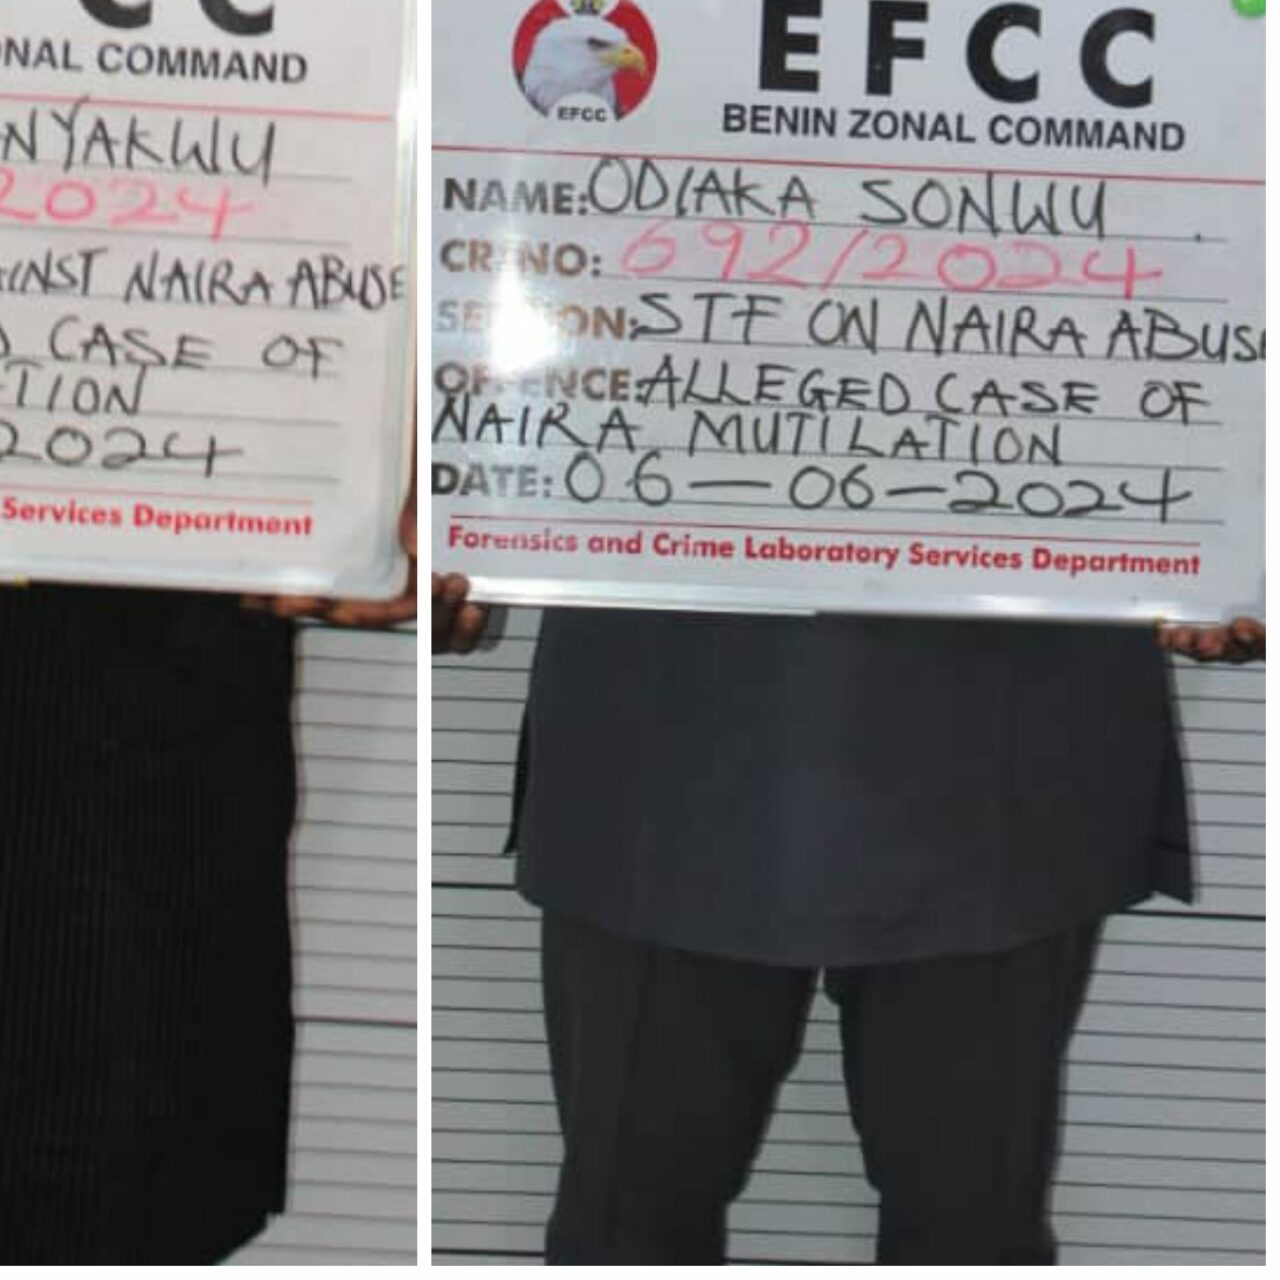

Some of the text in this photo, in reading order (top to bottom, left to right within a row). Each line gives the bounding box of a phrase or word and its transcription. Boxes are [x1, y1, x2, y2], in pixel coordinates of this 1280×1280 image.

[97, 43, 308, 85] COMMAND
[557, 106, 608, 123] EFCC
[723, 103, 1186, 151] BENIN ZONAL COMMAND
[443, 177, 589, 216] NAME:
[124, 250, 272, 306] NAIRA
[621, 219, 1163, 303] 692/2024
[50, 315, 214, 369] CASE
[262, 334, 343, 379] OF
[634, 292, 784, 344] STF
[808, 298, 877, 354] ON
[905, 296, 1087, 357] NAIRA
[1106, 307, 1266, 363] ABUS
[634, 353, 910, 415] ALLEGED
[936, 372, 1099, 418] CASE
[1140, 381, 1211, 426] OF
[432, 391, 1062, 466] NAIRA MUTILATION
[432, 462, 553, 498] DATE:
[2, 495, 123, 526] Services
[132, 502, 313, 536] Department
[448, 524, 1201, 577] Forensics and Crime Laboratory Services Department
